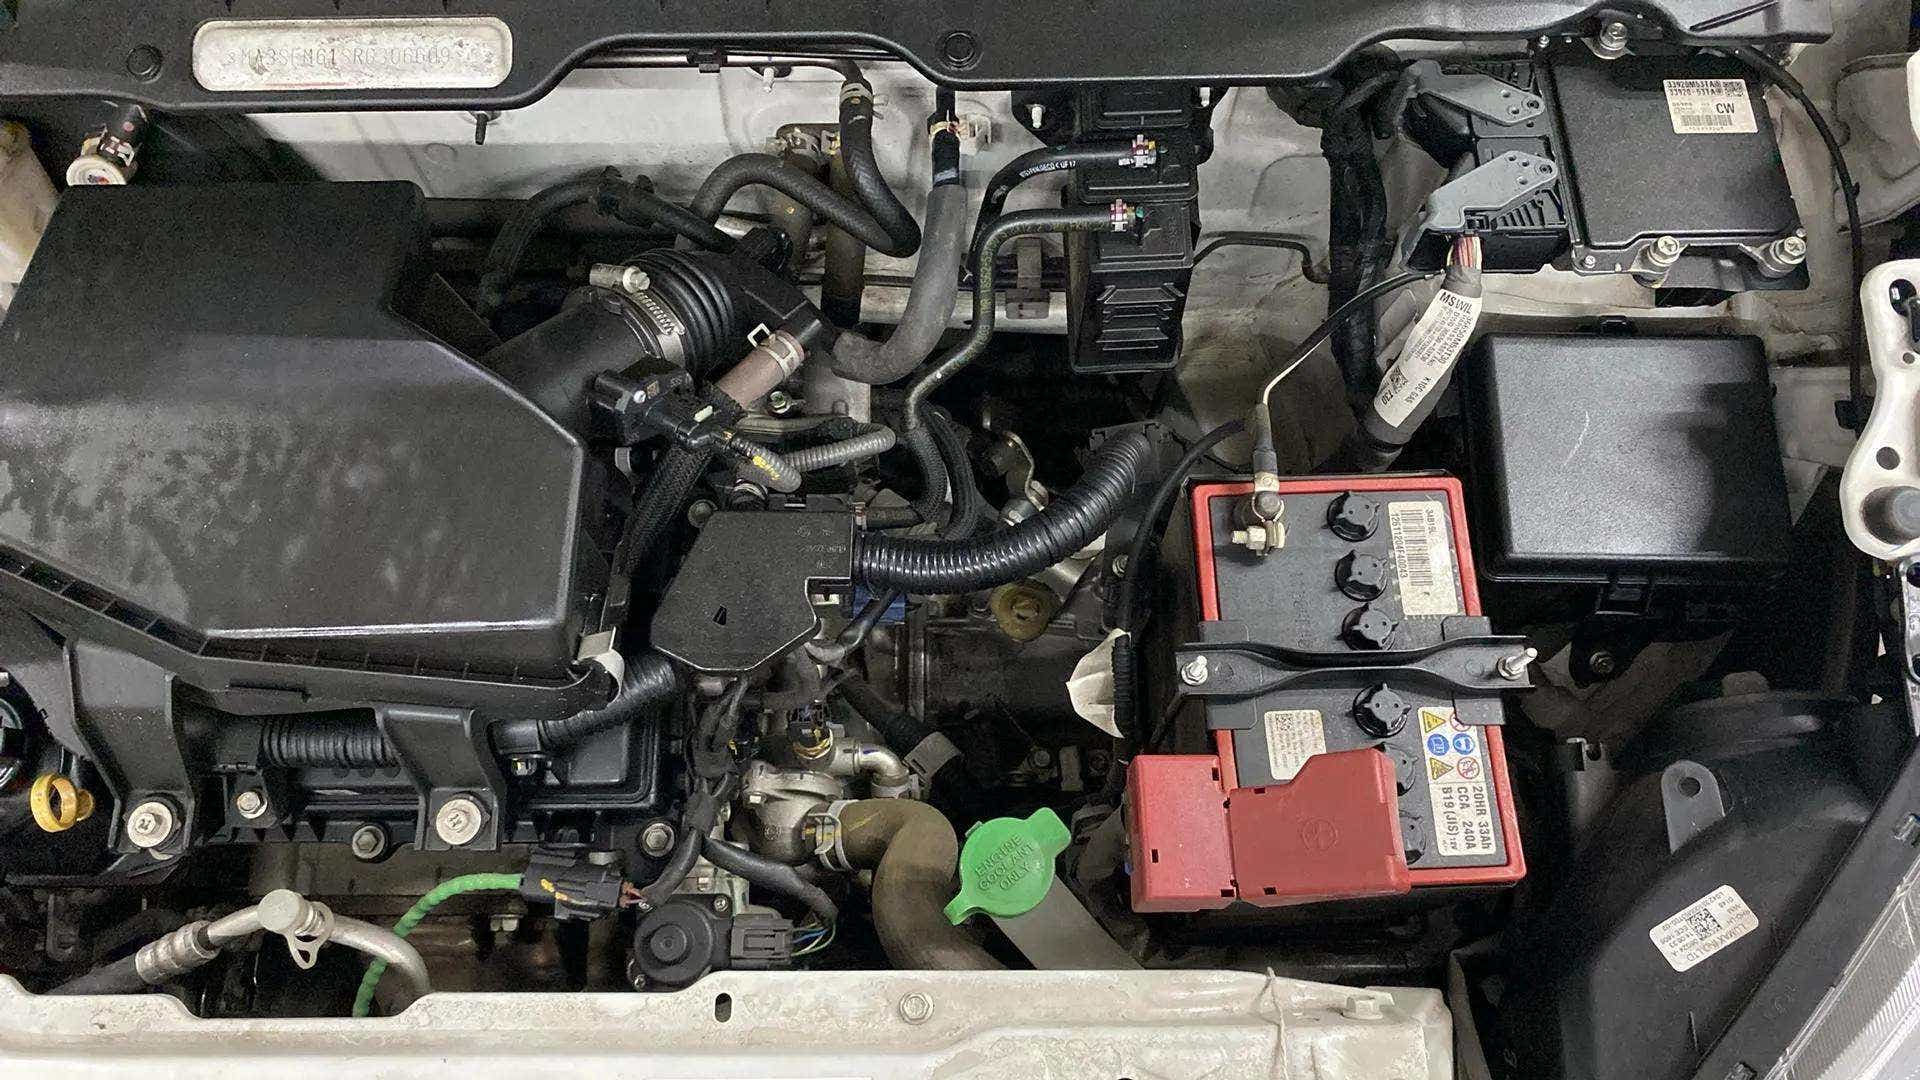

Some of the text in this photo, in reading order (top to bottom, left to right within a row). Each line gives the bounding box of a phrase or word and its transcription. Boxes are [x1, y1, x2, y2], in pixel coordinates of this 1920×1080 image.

[1716, 102, 1735, 114] CW
[1457, 786, 1477, 850] CCA 240A
[1472, 785, 1492, 850] 20HR 33Ah
[975, 833, 1022, 877] ENGINE
[979, 843, 1034, 891] COOLANT
[1000, 861, 1030, 890] ONLY
